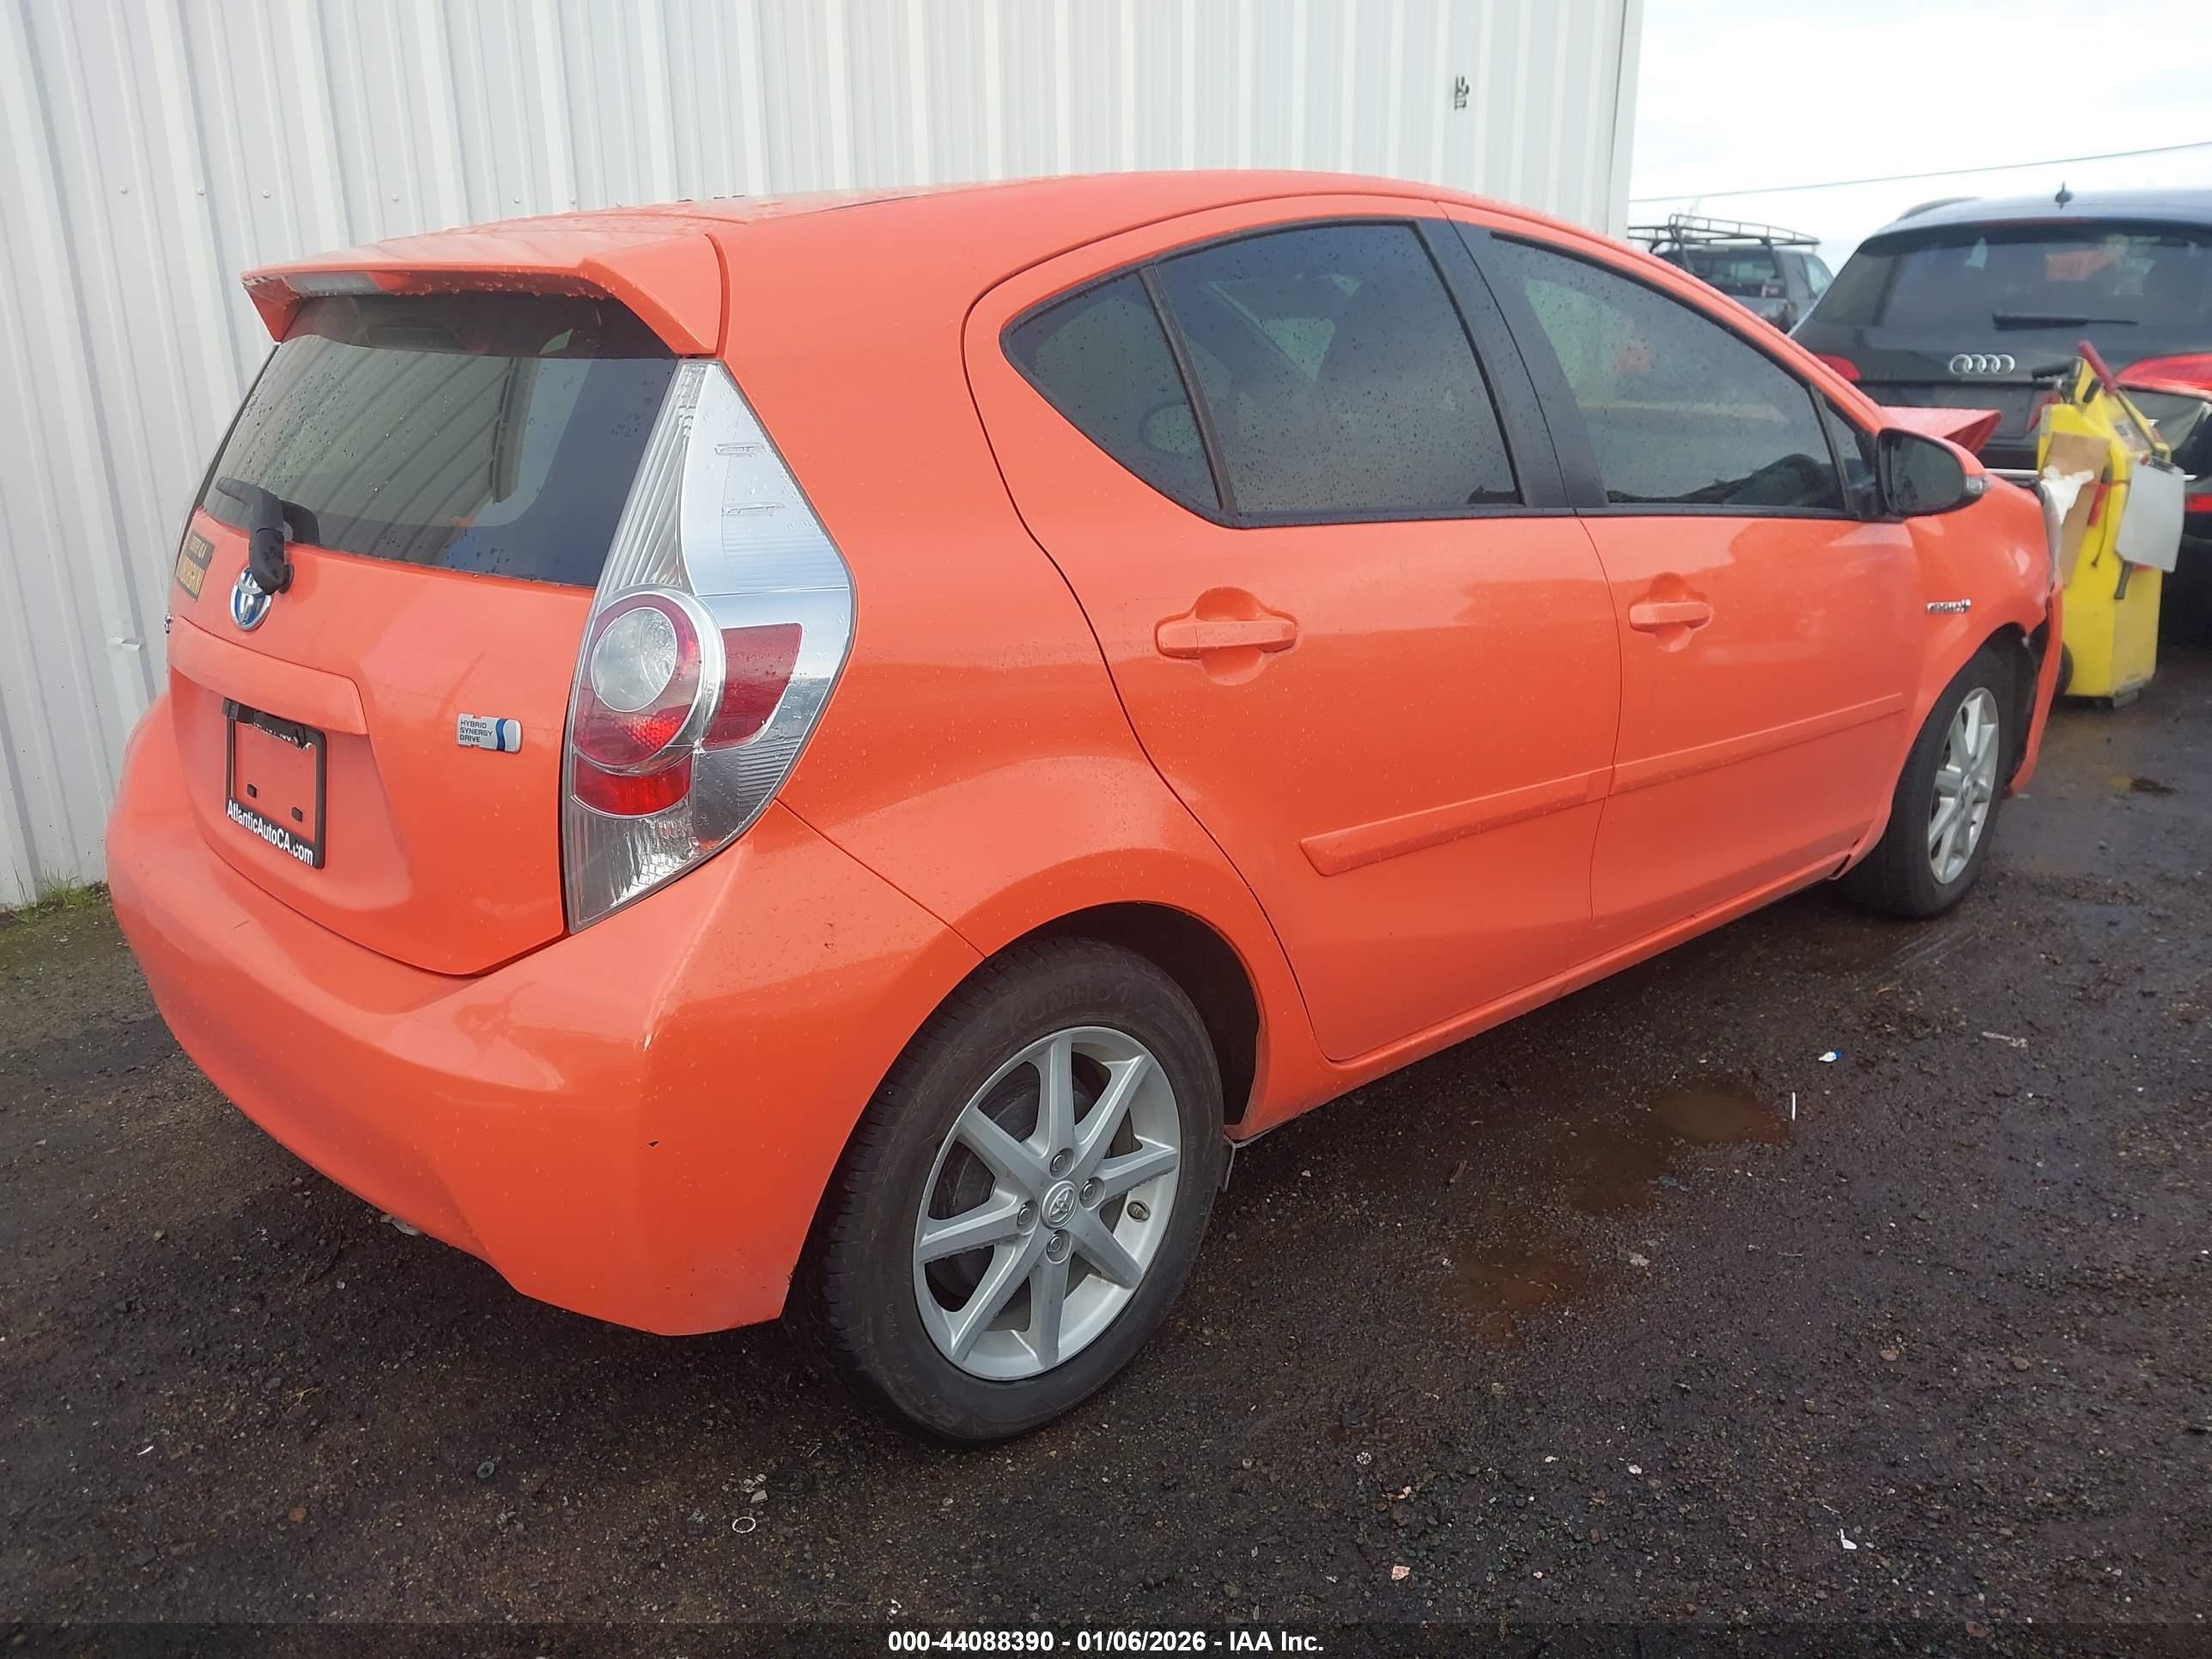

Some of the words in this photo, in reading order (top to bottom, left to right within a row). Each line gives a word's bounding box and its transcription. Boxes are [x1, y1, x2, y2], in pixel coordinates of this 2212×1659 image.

[460, 720, 487, 729] HYBRID
[459, 727, 493, 738] SYNERGY
[459, 734, 481, 743] DRIVE
[227, 799, 313, 866] AtlanticAutoCA.com
